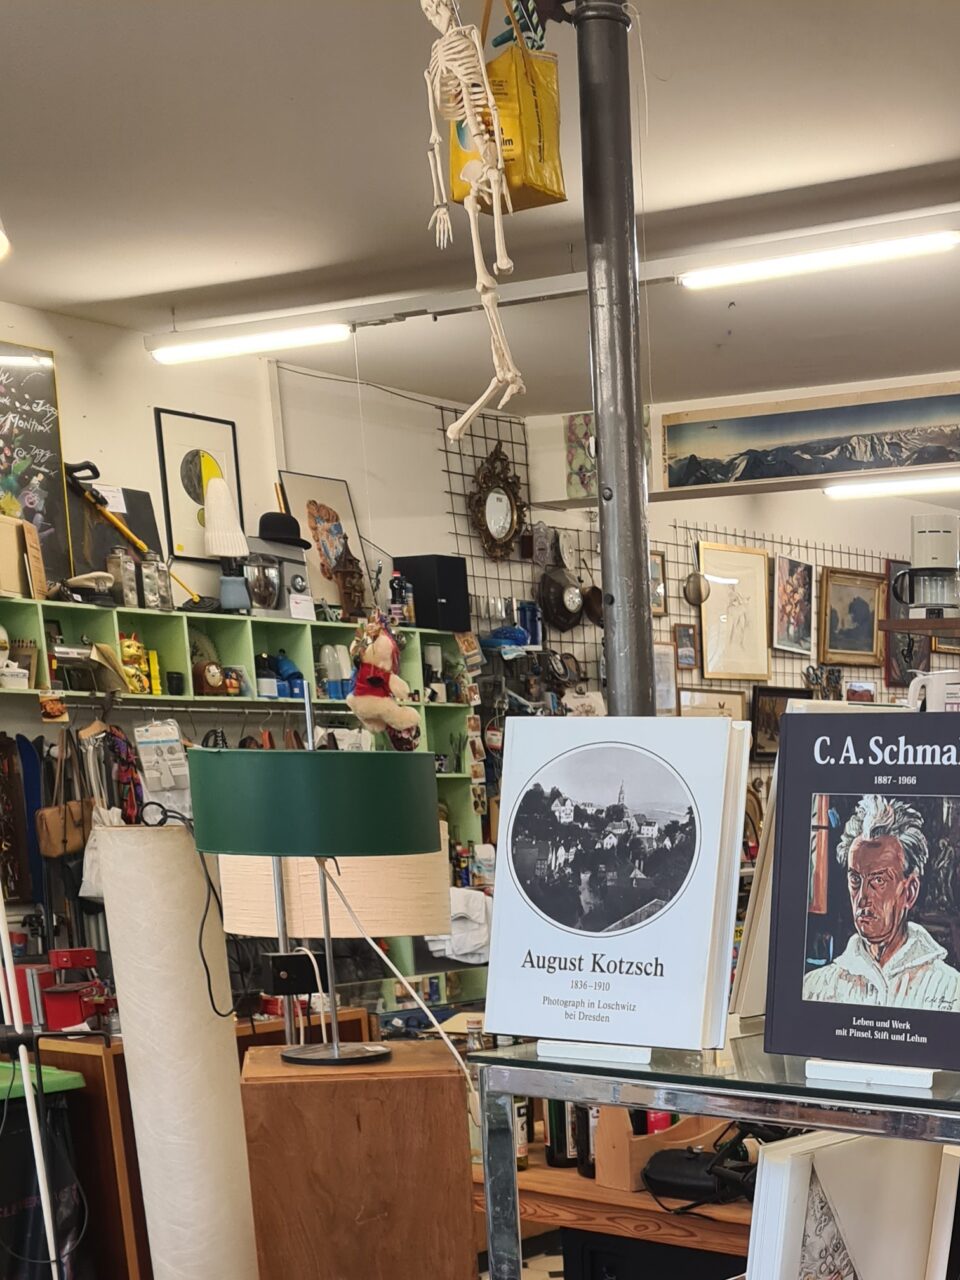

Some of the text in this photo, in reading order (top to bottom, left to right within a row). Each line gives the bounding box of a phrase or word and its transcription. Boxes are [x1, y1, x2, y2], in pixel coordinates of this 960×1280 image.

[813, 735, 835, 765] C.
[839, 735, 864, 765] A.
[521, 949, 665, 977] August Kotzsch
[542, 995, 637, 1012] Photograph in Loschwitz
[564, 1010, 610, 1023] bei Dresden
[852, 1016, 911, 1030] Leben und Werk
[835, 1028, 848, 1037] mit
[891, 1033, 905, 1042] und
[906, 1033, 928, 1044] Lehm
